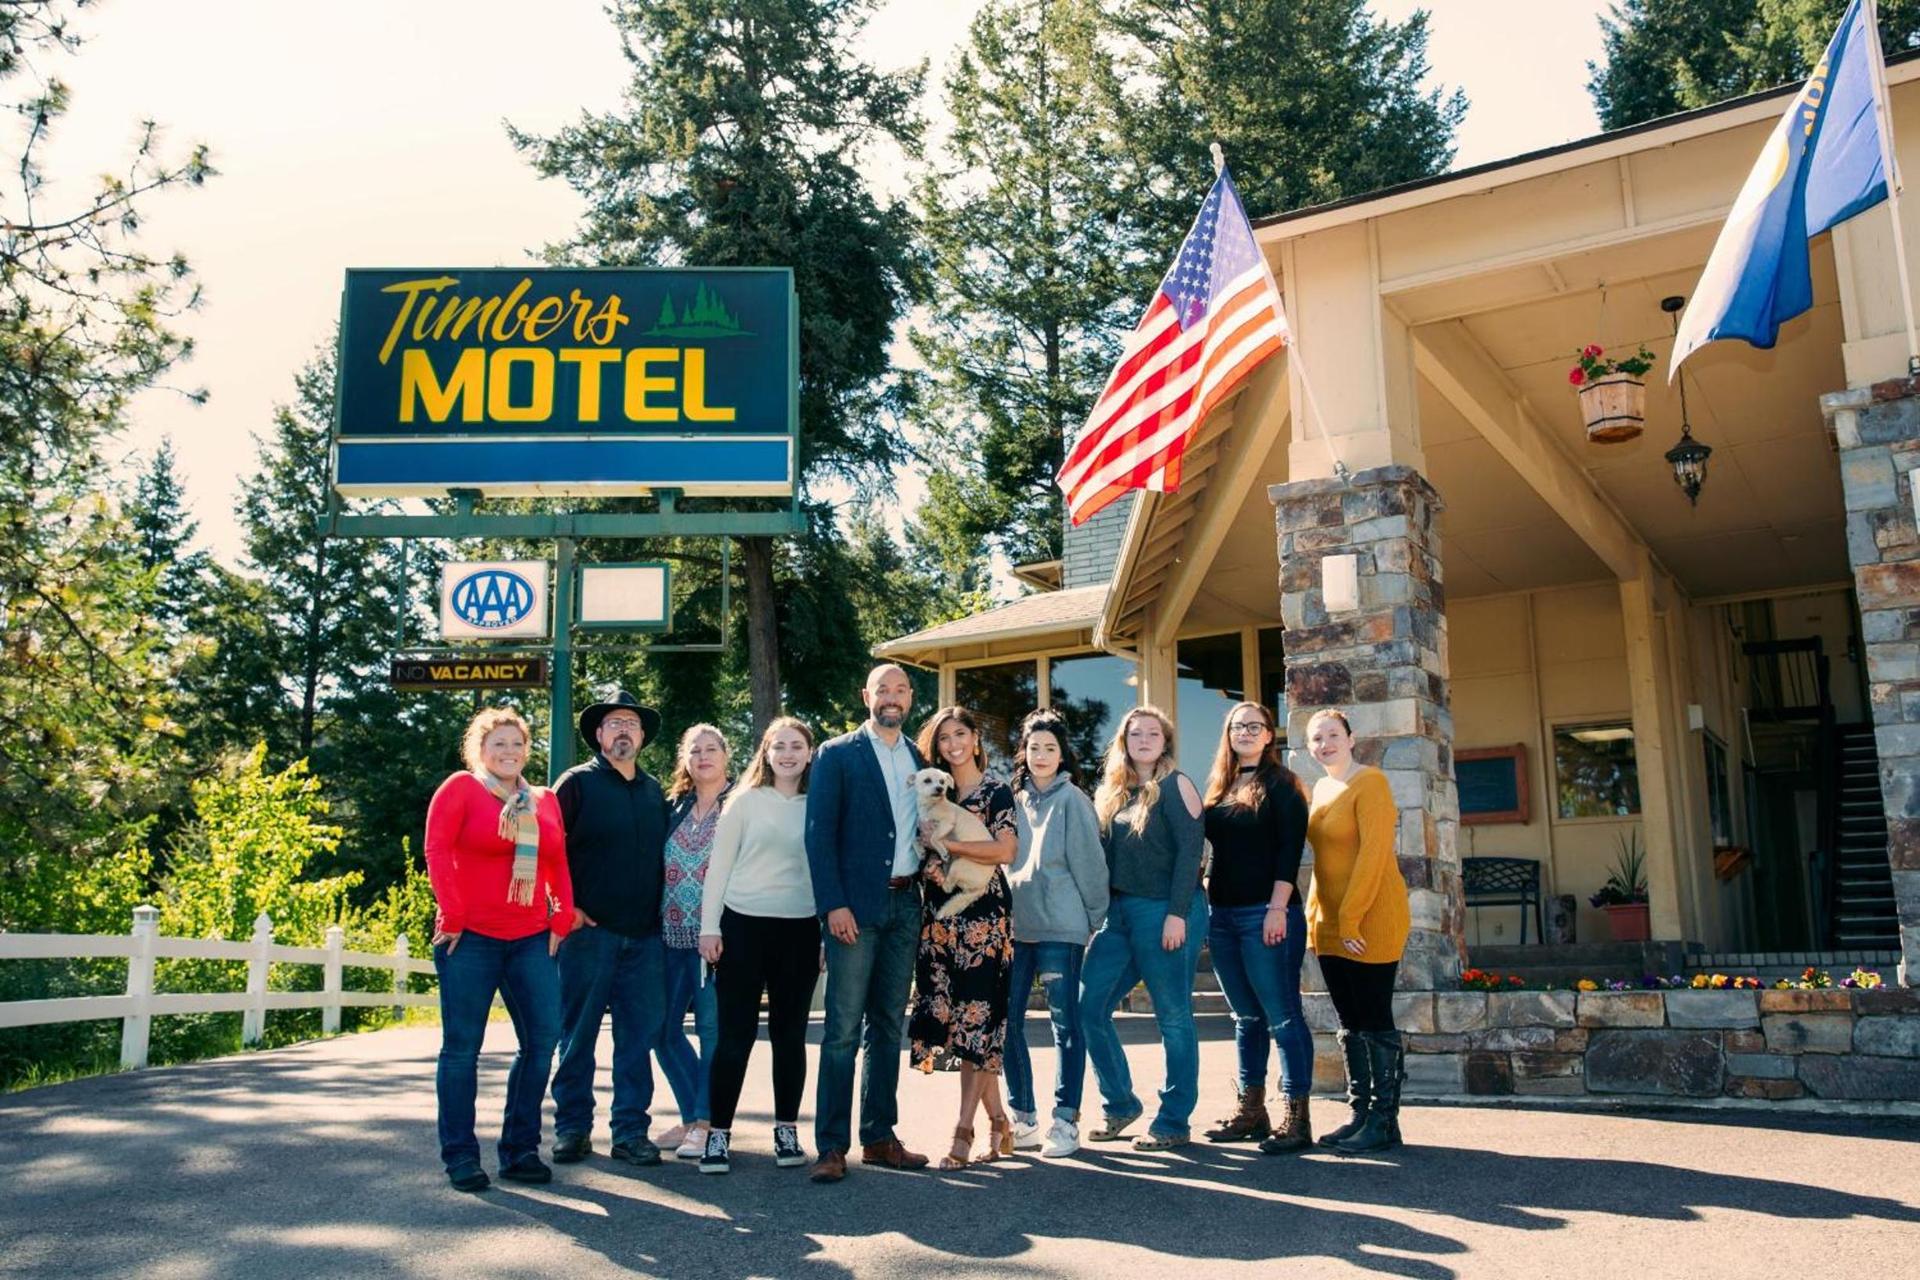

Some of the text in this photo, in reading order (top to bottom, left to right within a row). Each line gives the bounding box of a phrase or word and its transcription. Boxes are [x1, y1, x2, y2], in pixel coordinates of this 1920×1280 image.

[379, 276, 630, 365] Timbers
[400, 347, 735, 422] MOTEL
[461, 574, 524, 621] AAA
[396, 665, 528, 680] NO VACANCY
